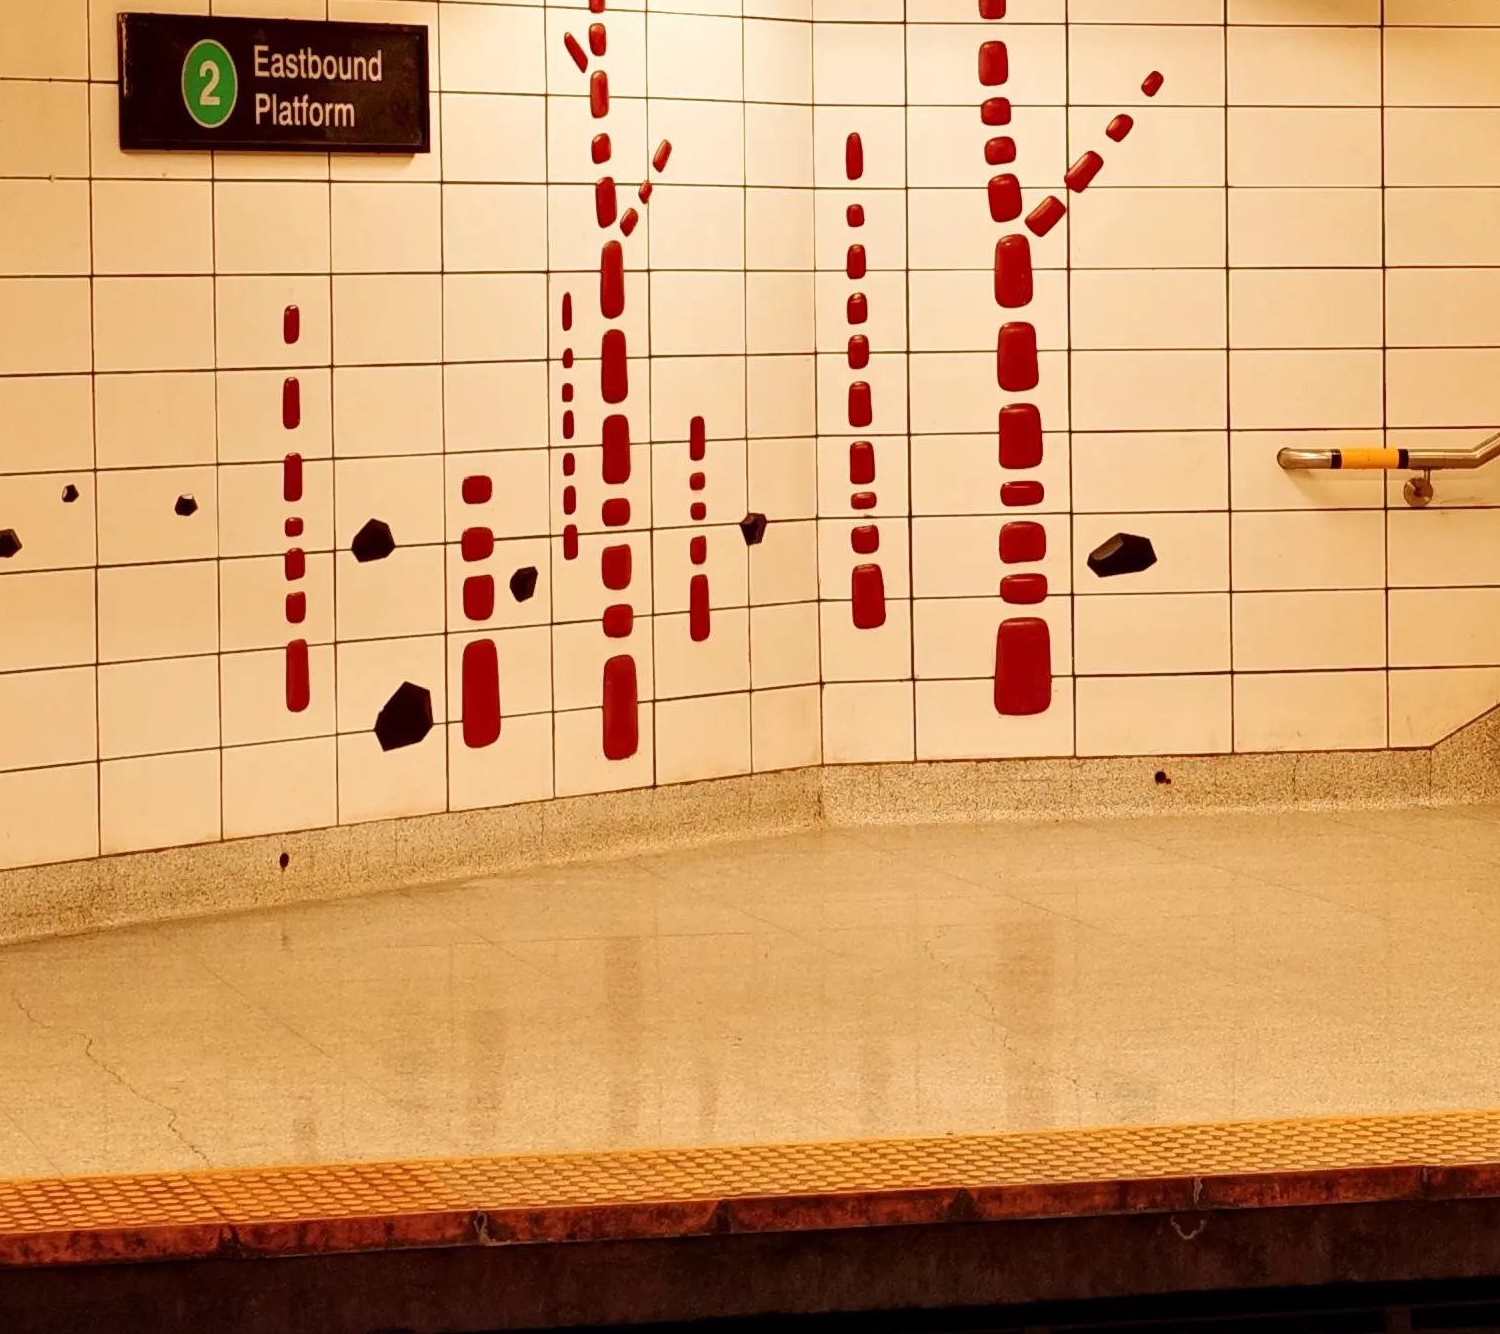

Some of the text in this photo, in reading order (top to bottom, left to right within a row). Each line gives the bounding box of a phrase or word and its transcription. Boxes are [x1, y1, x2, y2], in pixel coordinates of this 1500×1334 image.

[253, 44, 383, 82] Eastbound
[198, 59, 221, 106] 2
[254, 93, 356, 128] Platform
